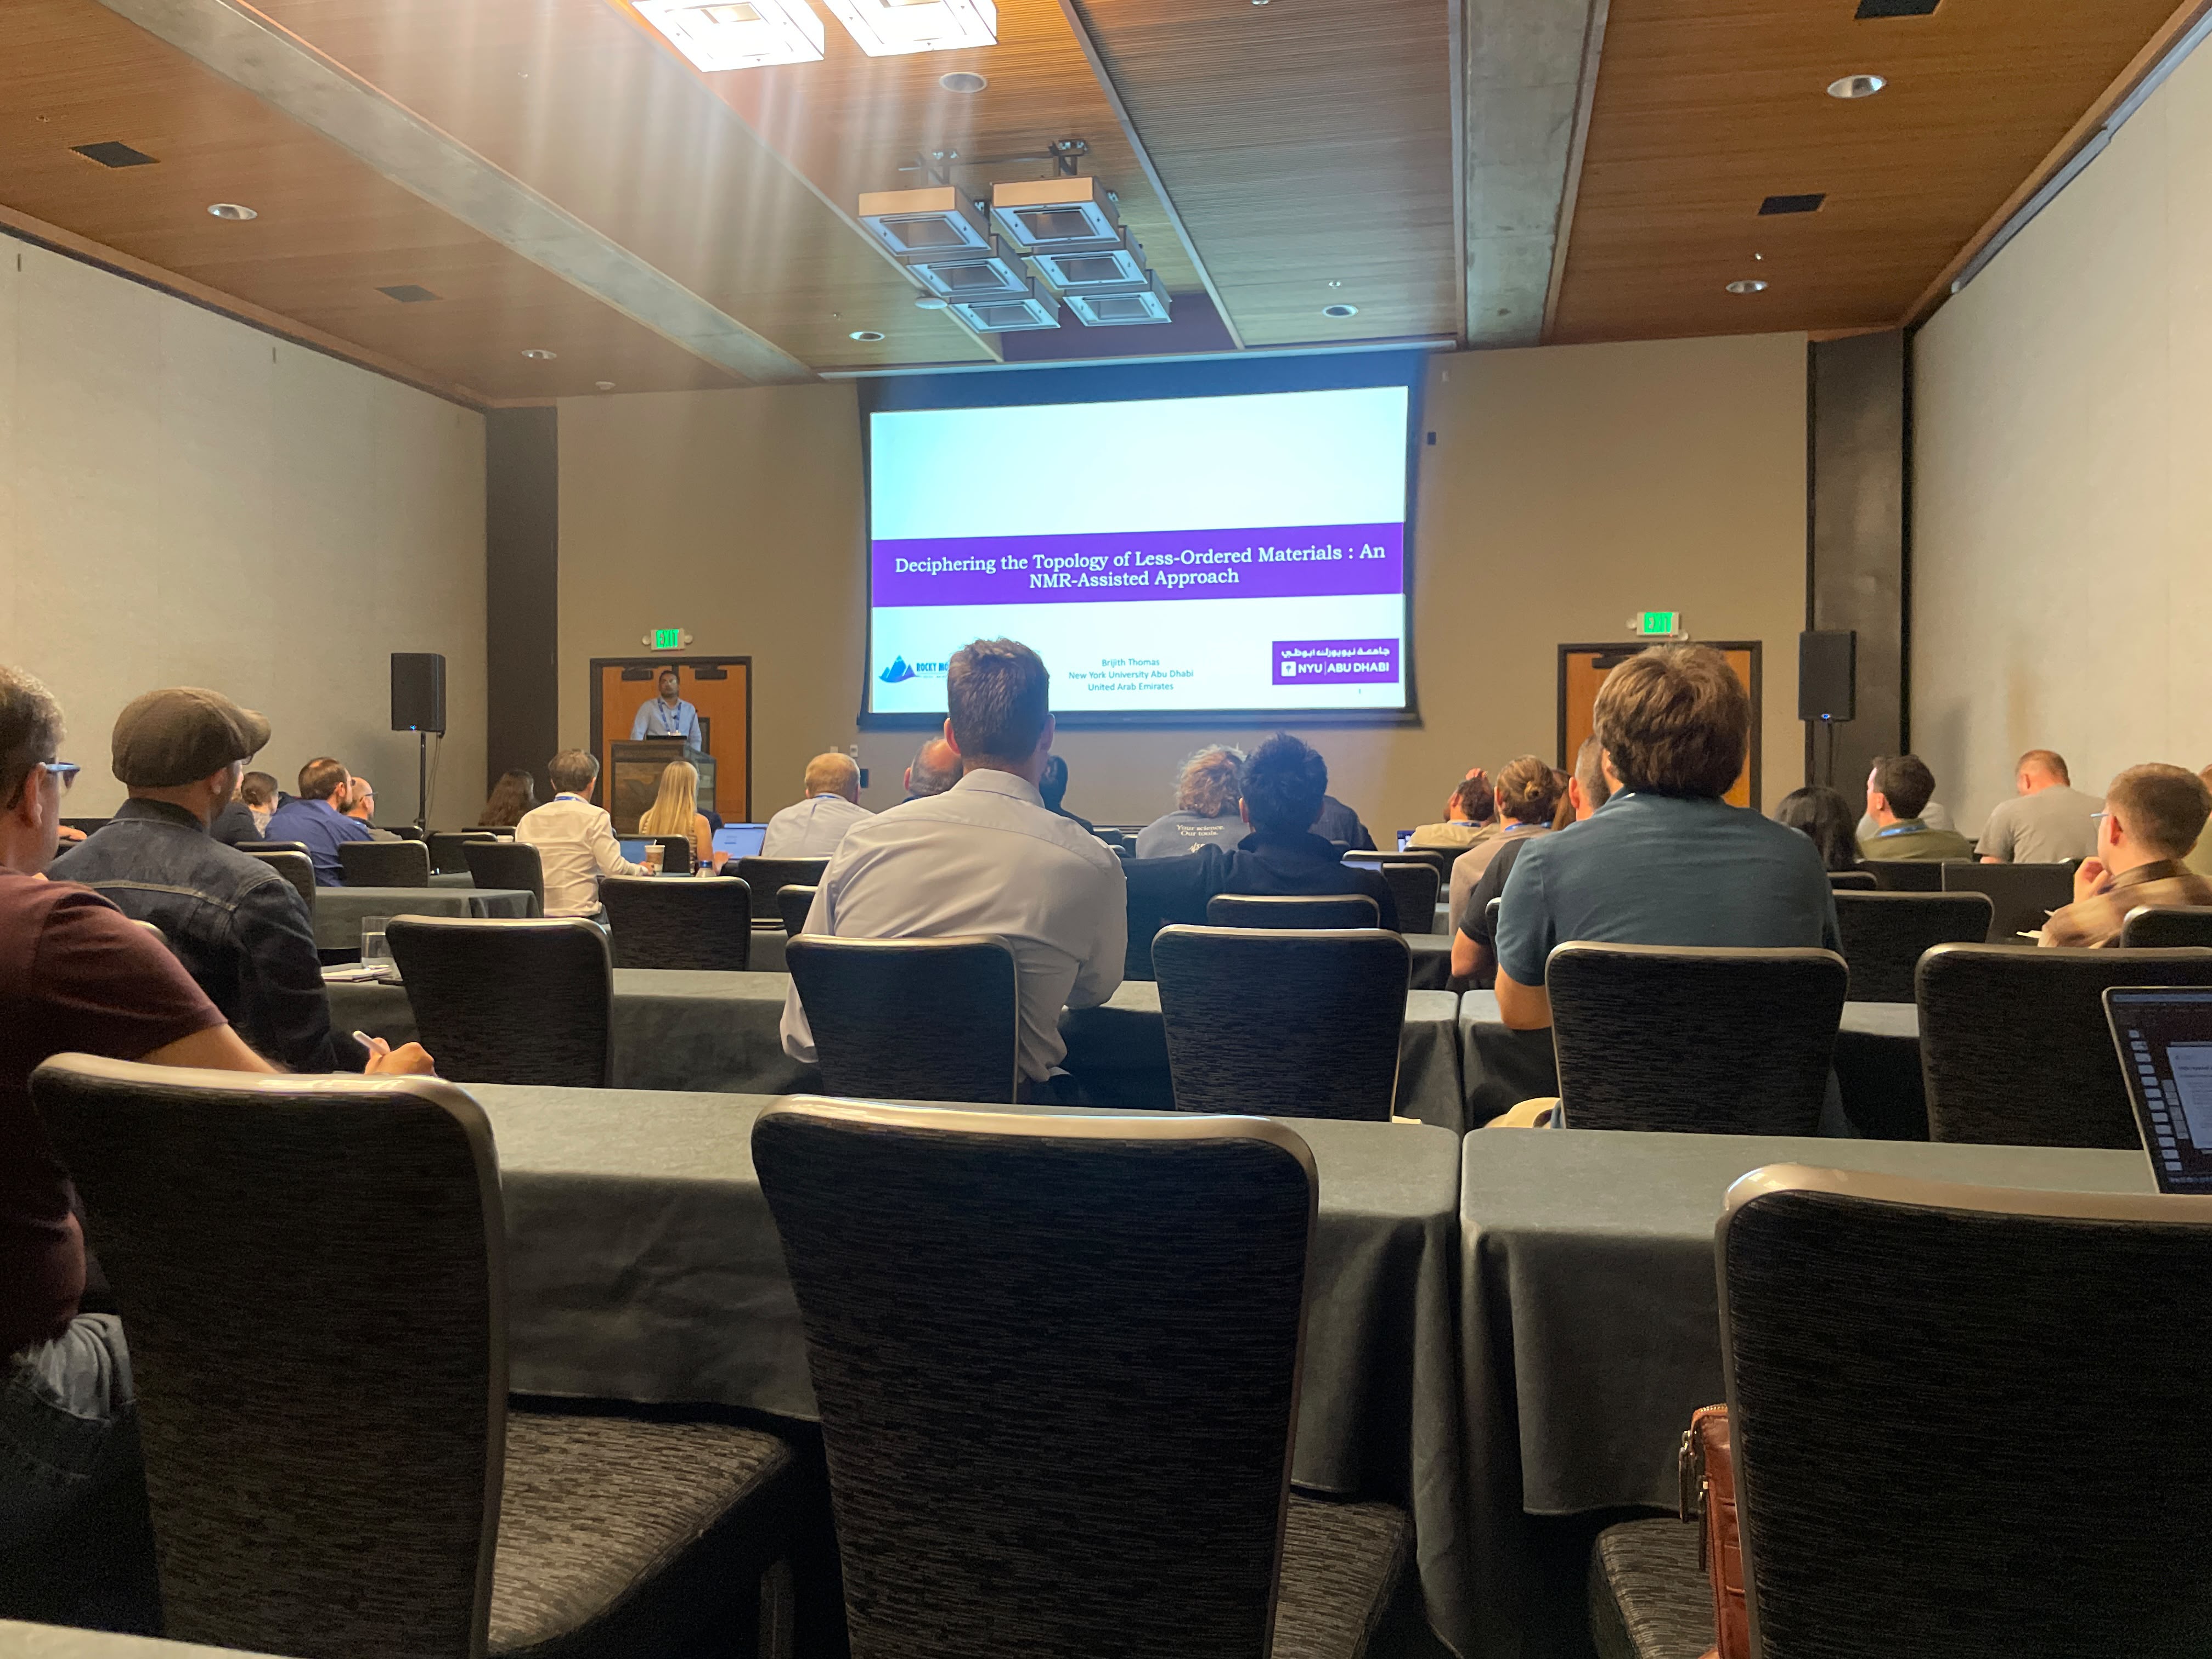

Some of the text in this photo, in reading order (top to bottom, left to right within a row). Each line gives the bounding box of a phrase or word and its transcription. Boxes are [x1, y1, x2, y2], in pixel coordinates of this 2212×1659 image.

[895, 556, 996, 575] Deciphering
[1001, 555, 1028, 570] the
[1032, 553, 1108, 572] Topology
[1114, 551, 1131, 567] of
[1135, 548, 1252, 566] Less-Ordered
[1258, 545, 1342, 562] Materials
[1359, 544, 1385, 559] An
[1029, 568, 1239, 589] NMR-Assisted Approach
[1644, 612, 1673, 633] EXIT
[656, 629, 679, 648] EXIT
[916, 662, 937, 672] ROCKY
[1102, 658, 1126, 668] Brijith
[1298, 662, 1390, 673] NYU ABU DHABI
[1109, 670, 1149, 680] University
[1170, 669, 1194, 678] Dhabi
[1088, 683, 1115, 691] United
[1117, 682, 1136, 691] Arab
